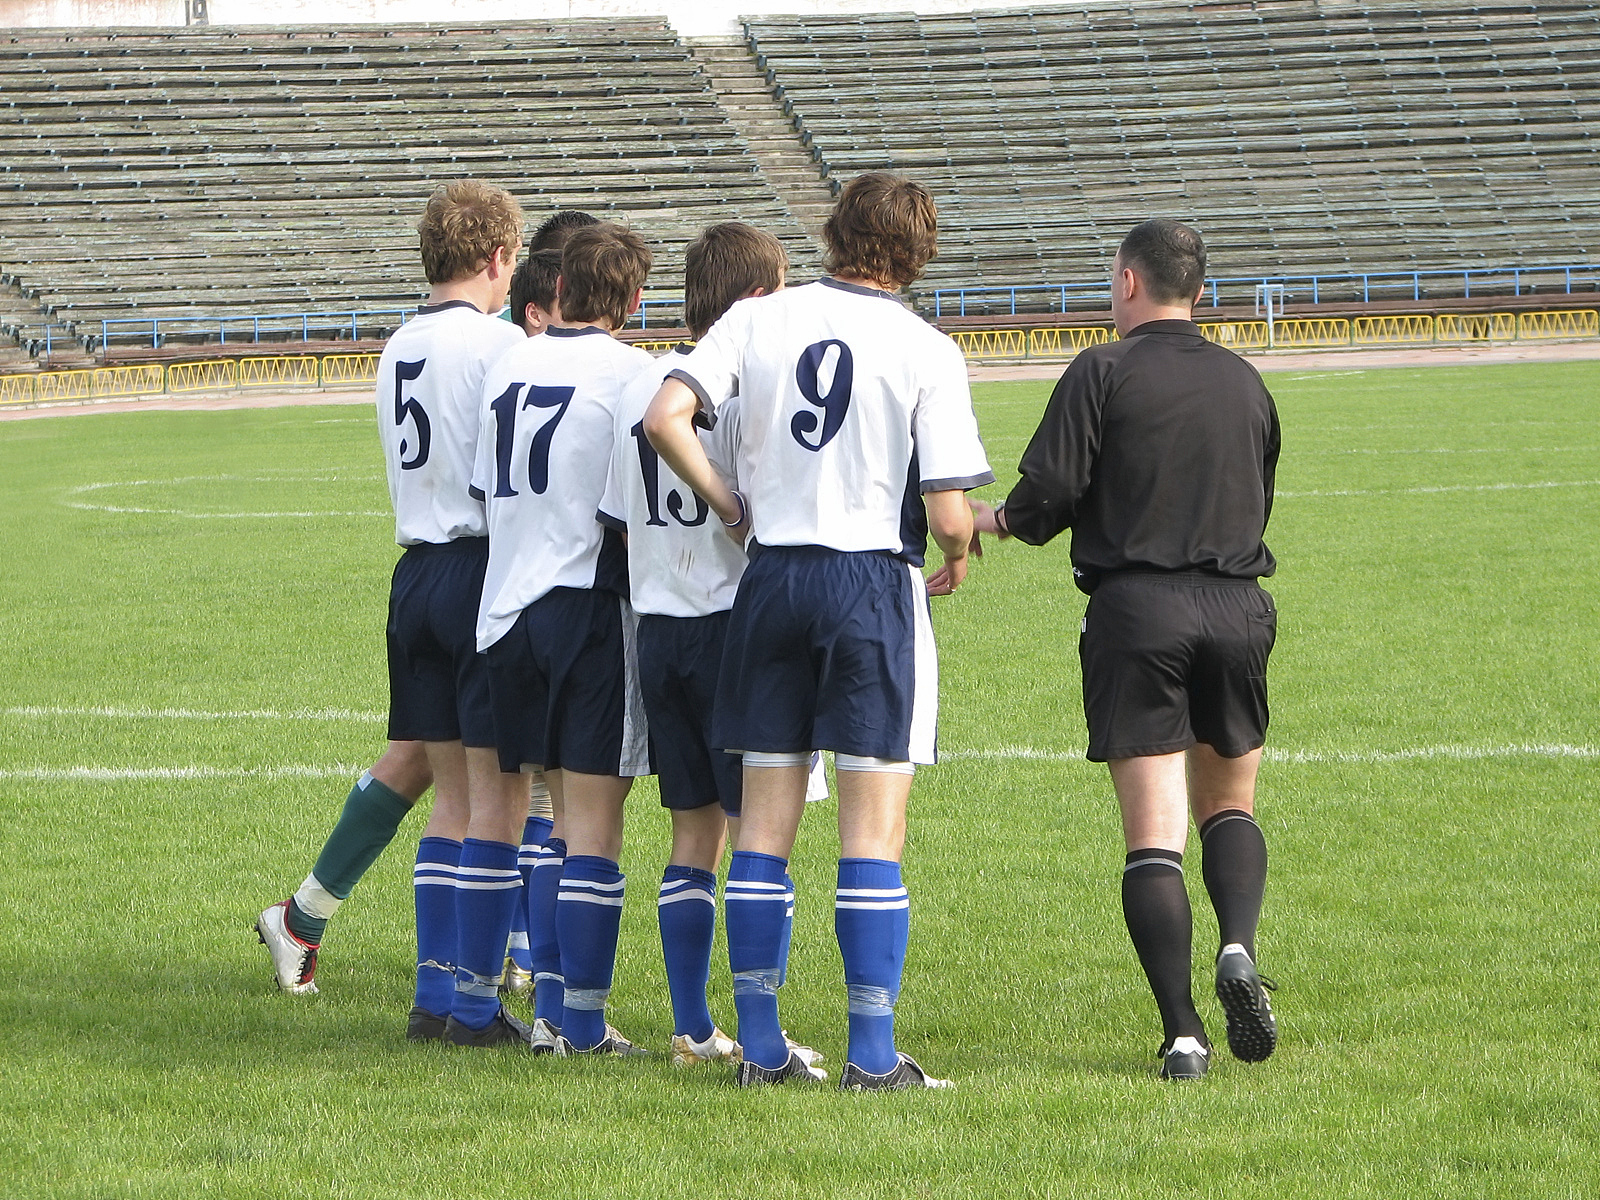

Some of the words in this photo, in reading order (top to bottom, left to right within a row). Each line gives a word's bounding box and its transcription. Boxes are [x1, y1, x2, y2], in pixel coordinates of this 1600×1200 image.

[395, 358, 431, 470] 5
[490, 382, 576, 498] 17
[791, 339, 853, 452] 9
